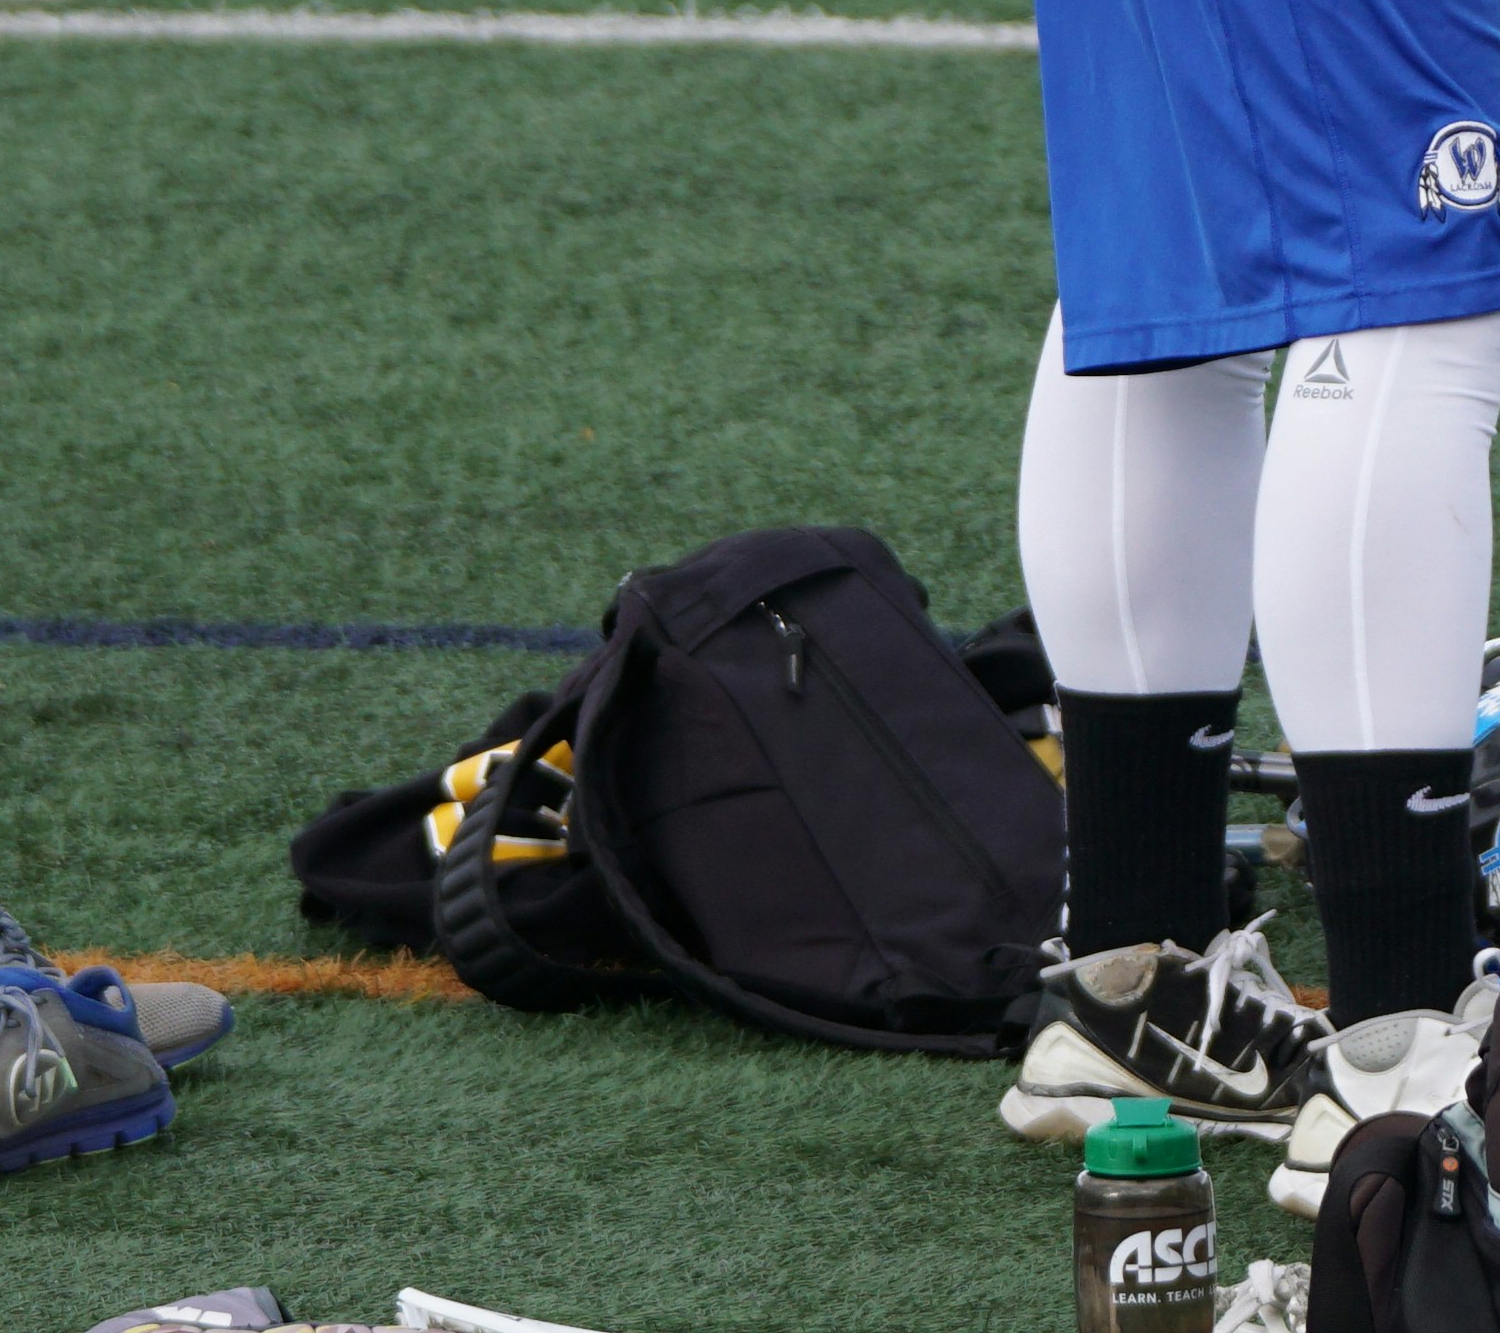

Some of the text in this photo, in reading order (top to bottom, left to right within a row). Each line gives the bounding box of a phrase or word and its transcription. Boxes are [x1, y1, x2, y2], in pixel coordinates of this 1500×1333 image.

[1293, 384, 1354, 400] Reebok
[1441, 1178, 1455, 1212] STX
[1112, 1292, 1162, 1304] LEARN.
